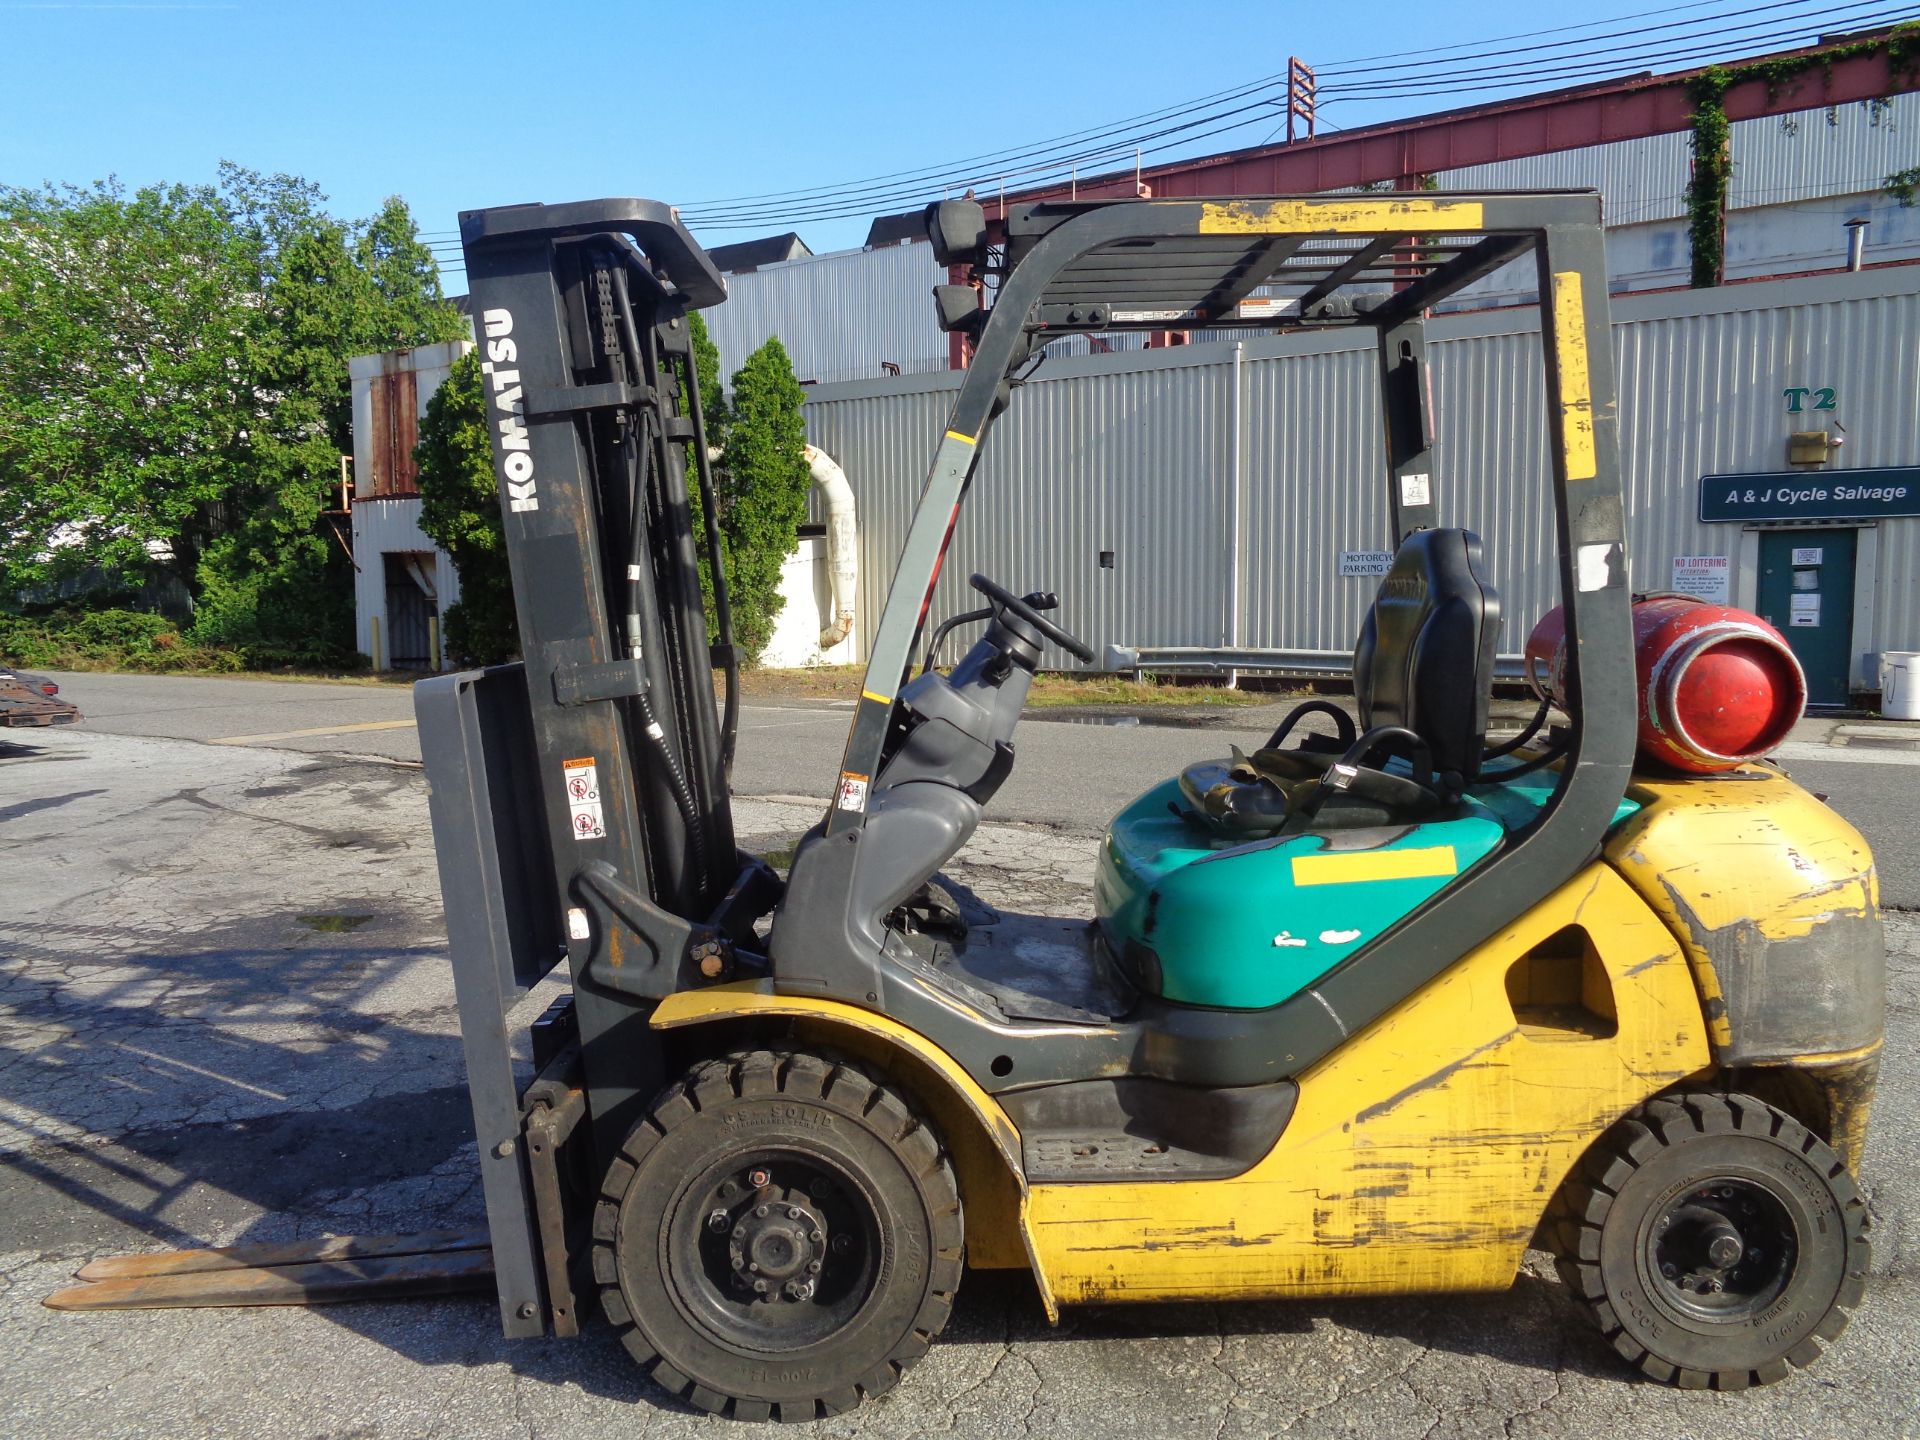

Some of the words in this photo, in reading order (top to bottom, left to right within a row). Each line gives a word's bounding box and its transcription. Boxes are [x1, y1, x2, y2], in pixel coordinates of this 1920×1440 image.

[481, 308, 539, 512] KOMATSU
[1725, 490, 1739, 503] A
[1743, 489, 1756, 503] &
[1760, 489, 1772, 503] J
[1777, 487, 1828, 505] Cycle
[1833, 485, 1907, 502] Salvage
[1343, 564, 1383, 573] PARKING
[1675, 558, 1685, 568] NO
[1688, 558, 1727, 568] LOITERING
